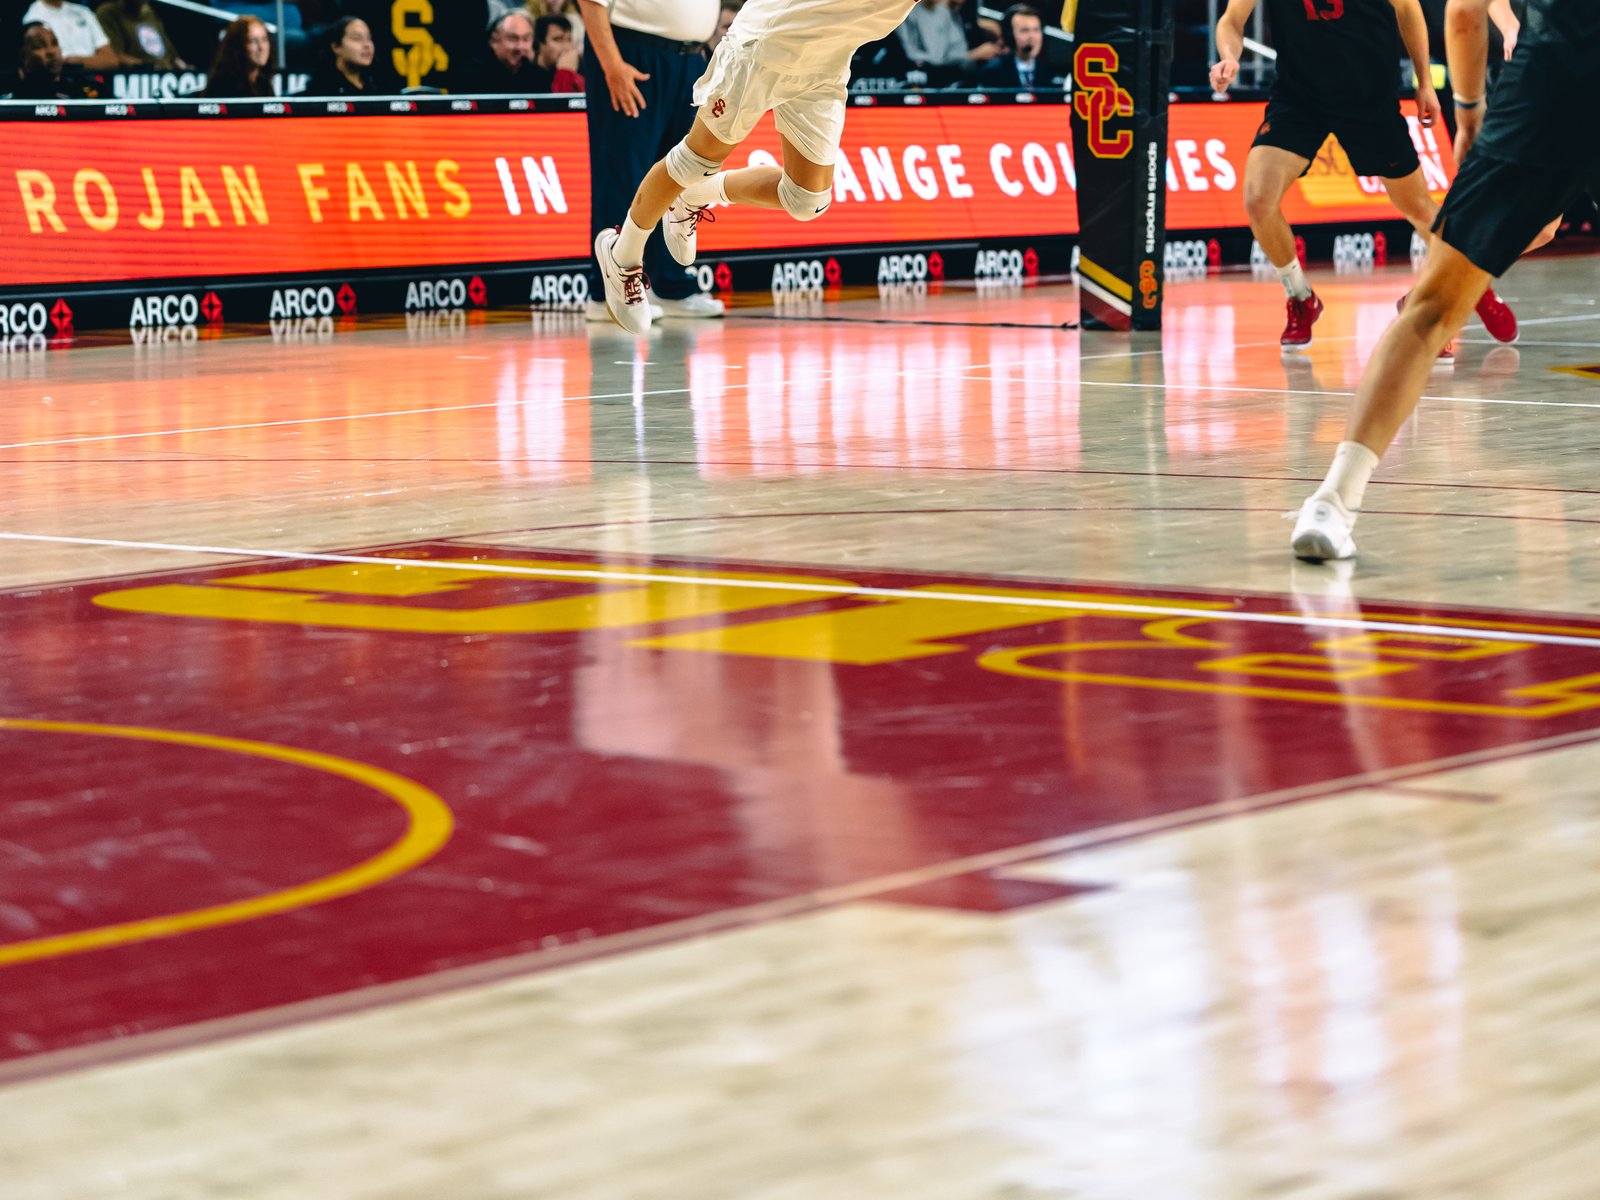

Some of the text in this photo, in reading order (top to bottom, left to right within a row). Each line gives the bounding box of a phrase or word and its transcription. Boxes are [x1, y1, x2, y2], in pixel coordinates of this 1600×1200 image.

[1074, 43, 1134, 159] SC
[16, 165, 269, 233] ROJAN
[297, 160, 472, 222] FANS
[495, 156, 568, 215] IN
[772, 260, 824, 290] ARCO
[877, 254, 928, 282] ARCO
[974, 249, 1024, 276] ARCO
[405, 279, 466, 309] ARCO
[530, 273, 589, 301] ARCO
[130, 294, 199, 326] ARCO
[270, 287, 335, 318] ARCO
